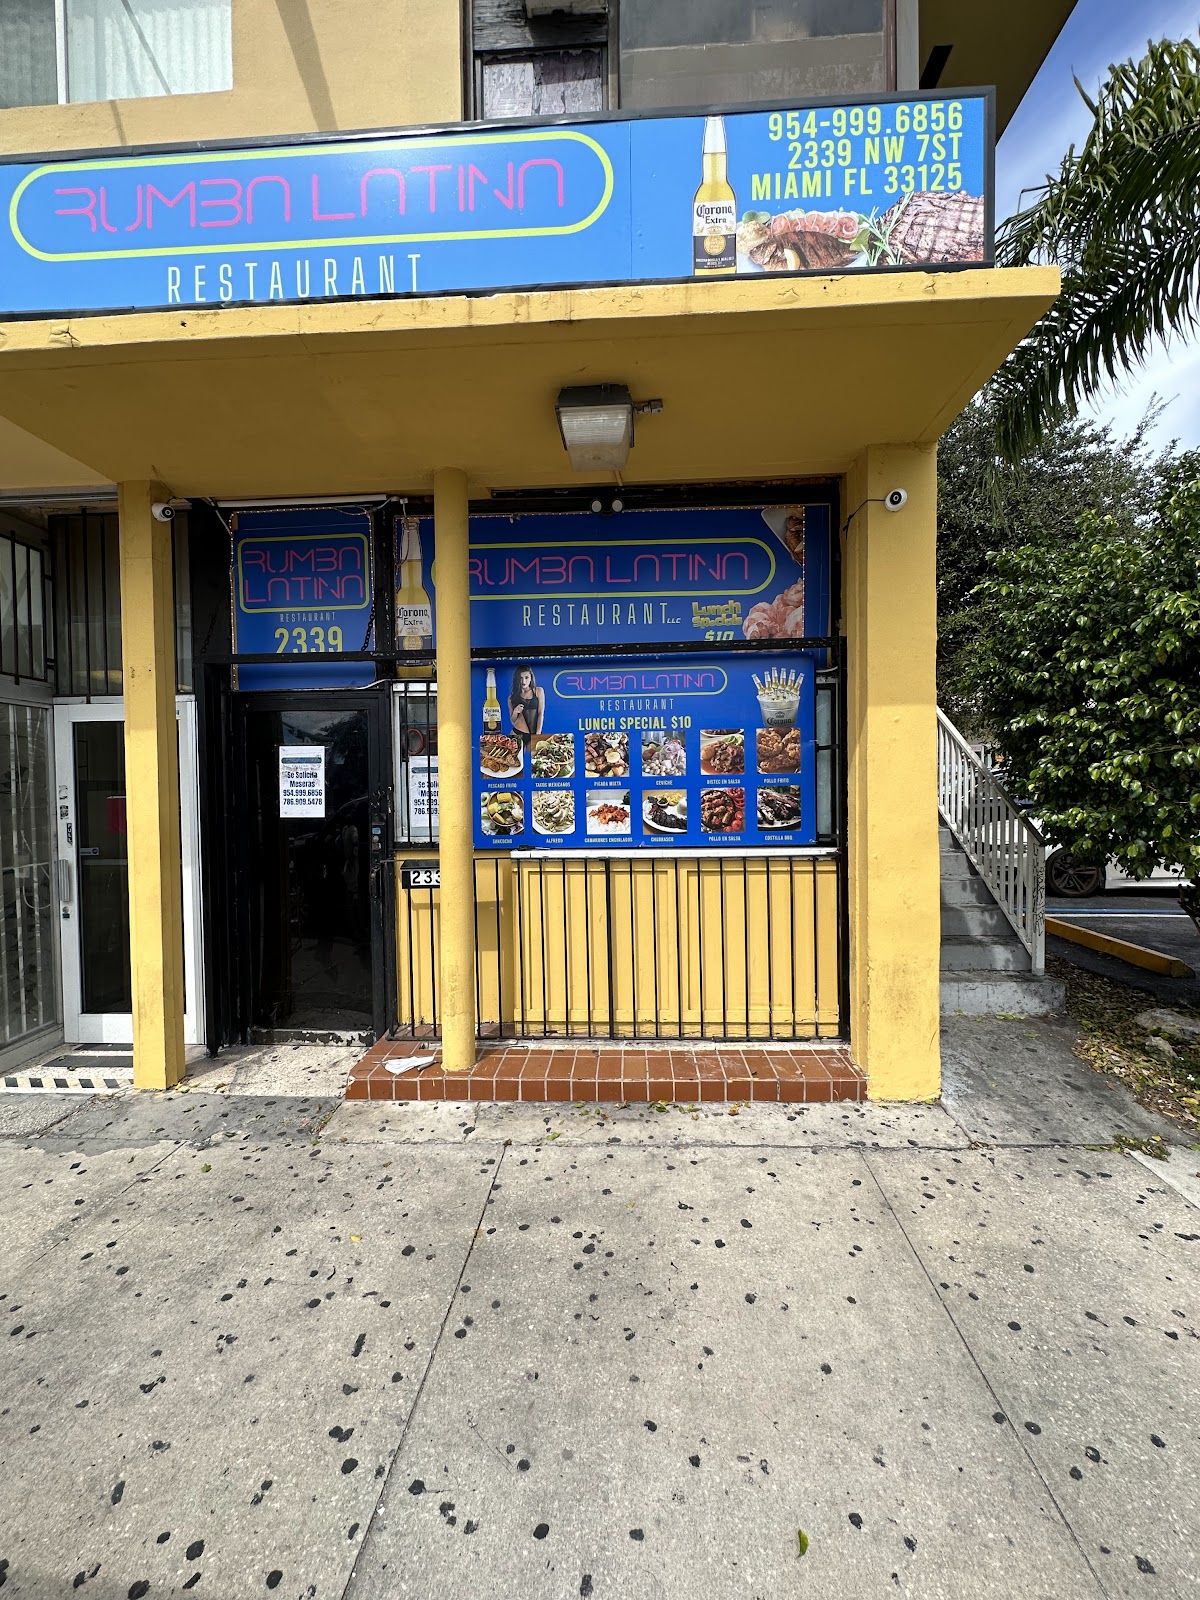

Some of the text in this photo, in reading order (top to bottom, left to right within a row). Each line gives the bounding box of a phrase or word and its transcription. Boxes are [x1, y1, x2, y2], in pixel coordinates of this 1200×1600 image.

[768, 101, 963, 141] 954-999.6856
[788, 132, 964, 169] 2339 NW 7ST
[751, 163, 963, 201] MIAMI FL 33125
[54, 158, 565, 233] RUMBA LATINA
[696, 204, 735, 218] Corona
[705, 216, 727, 224] Extra
[167, 253, 423, 303] RESTAURANT
[244, 546, 361, 574] RUMBA
[606, 552, 748, 583] LATINA
[245, 575, 364, 603] LATINA
[280, 611, 336, 623] RESTAURANT
[522, 602, 668, 627] RESTAURANT
[692, 600, 741, 616] Lunch
[403, 617, 424, 626] Extra
[274, 626, 343, 653] 2339
[704, 630, 735, 641] $10
[566, 673, 715, 691] RUMBA LATINA
[600, 698, 674, 712] RESTAURANT
[578, 715, 692, 731] LUNCH SPECIAL $10
[287, 771, 295, 779] Se
[289, 780, 316, 788] Meseras
